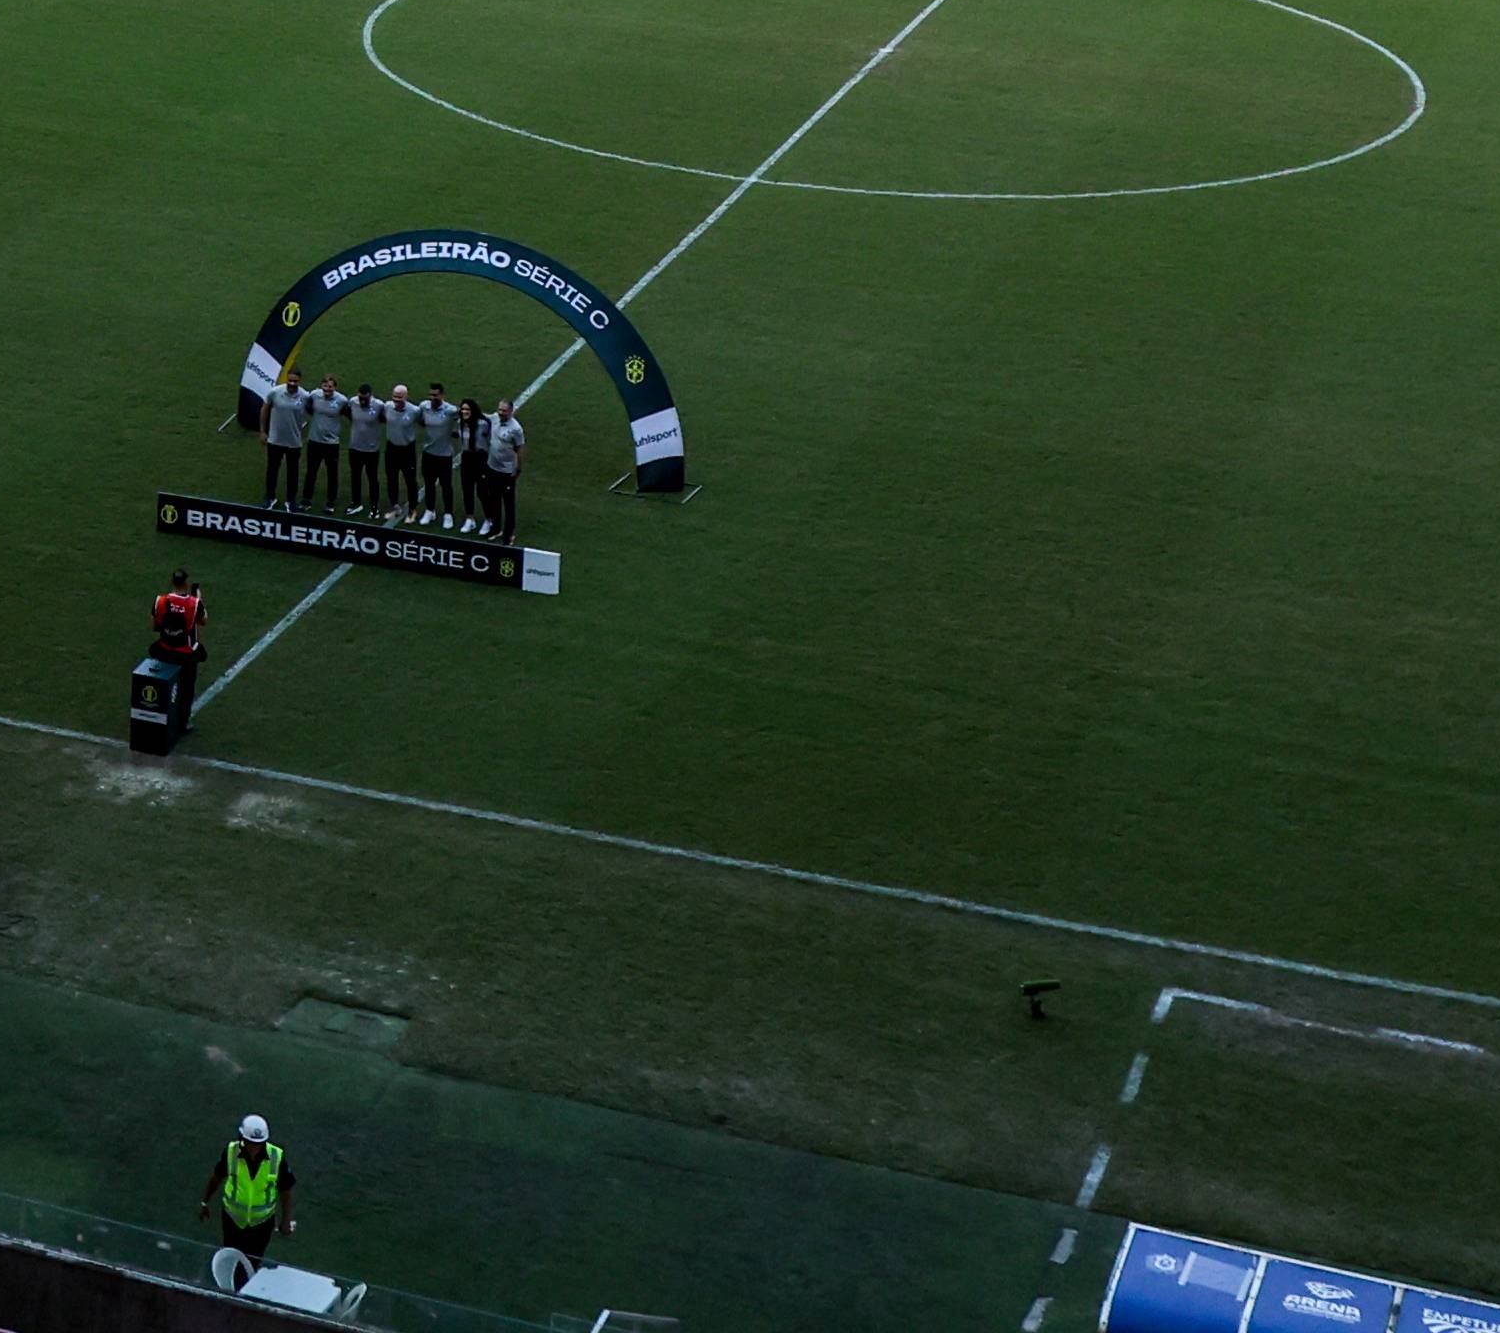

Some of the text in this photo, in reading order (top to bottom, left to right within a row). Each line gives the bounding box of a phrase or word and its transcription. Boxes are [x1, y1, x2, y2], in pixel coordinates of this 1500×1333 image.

[322, 240, 610, 330] BRASILEIRÃO SÉRIE C
[635, 427, 678, 447] uhlsport
[186, 509, 490, 572] BRASILEIRÃO SÉRIE C
[1283, 1293, 1361, 1318] ARENA
